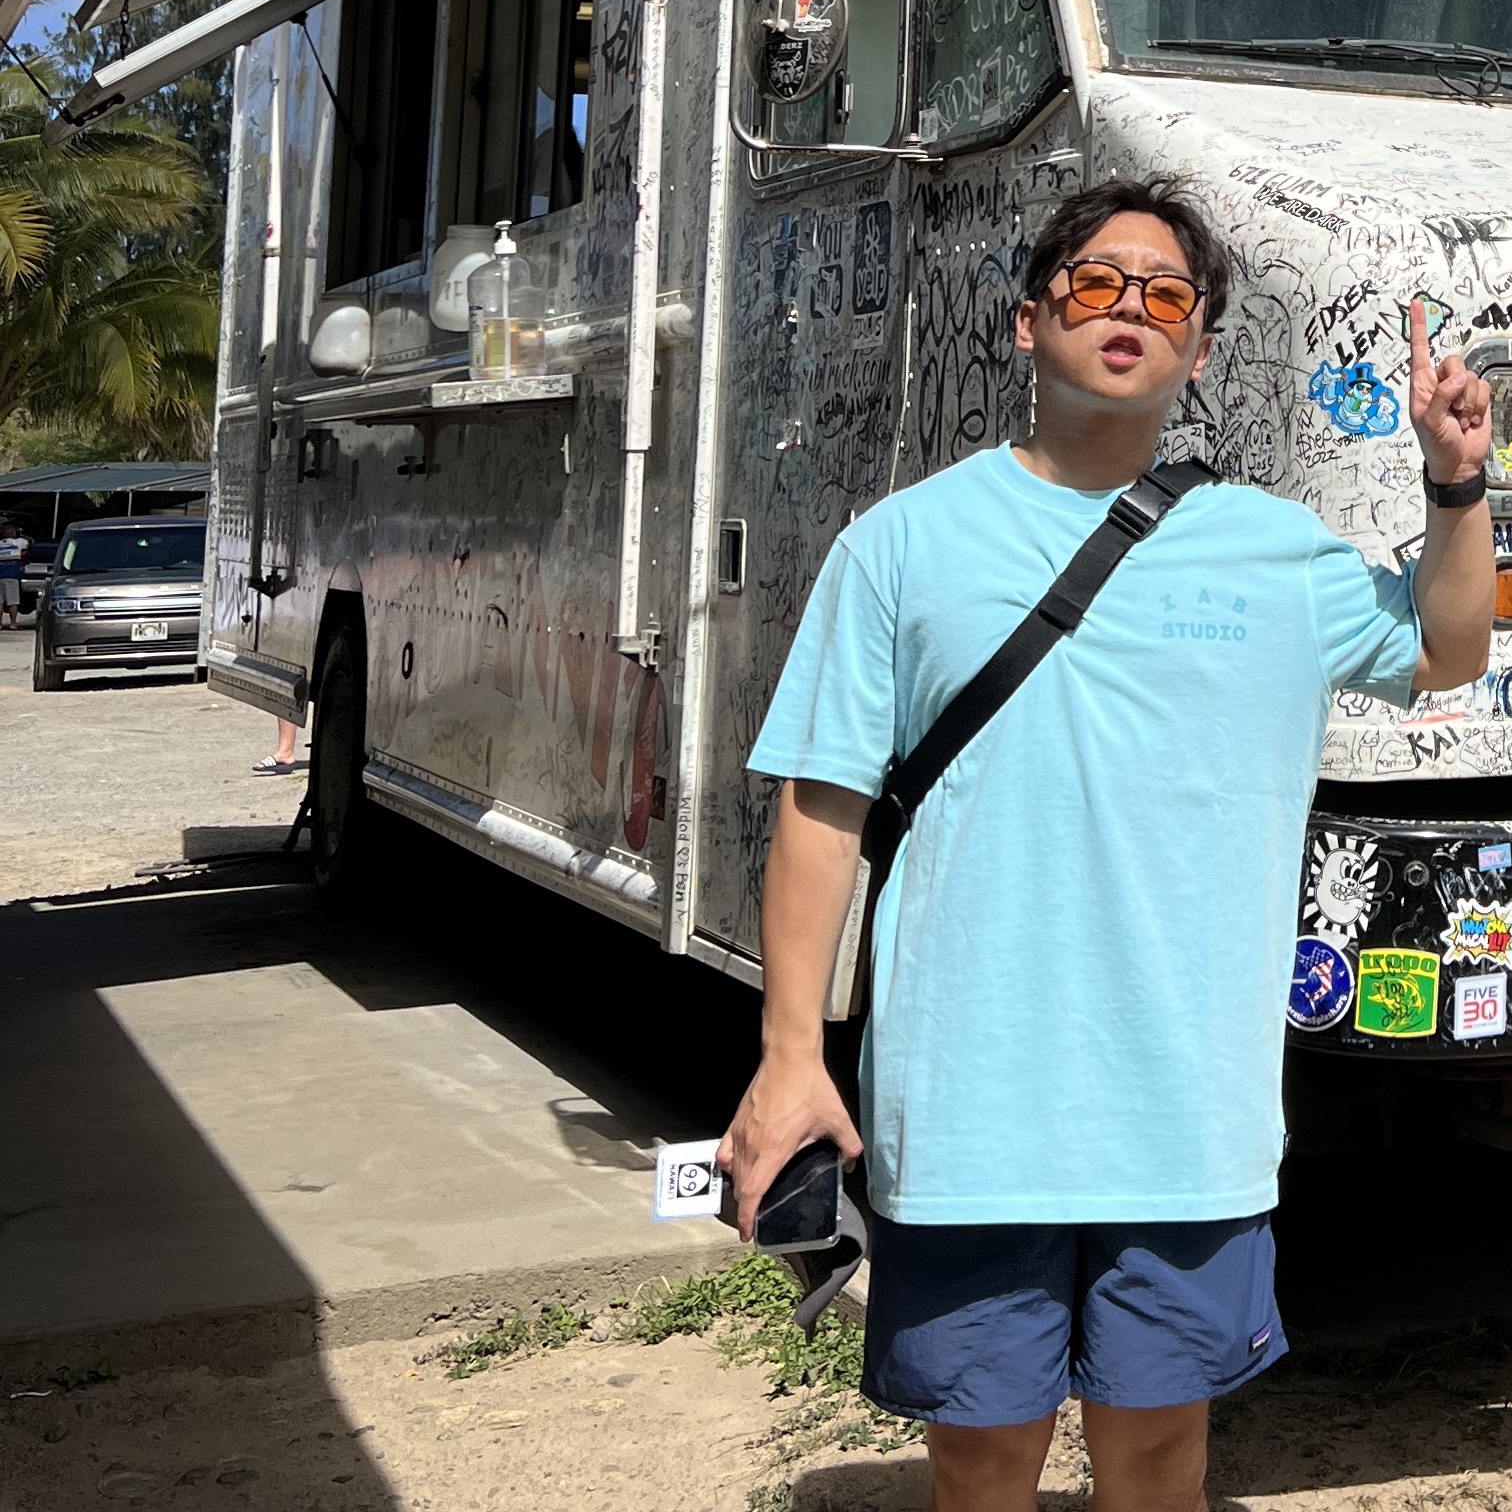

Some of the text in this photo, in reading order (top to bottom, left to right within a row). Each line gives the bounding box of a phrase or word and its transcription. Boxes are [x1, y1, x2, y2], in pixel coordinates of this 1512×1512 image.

[1264, 173, 1334, 198] GUAM
[1252, 186, 1350, 233] WE ARE DARK
[1161, 622, 1247, 642] STUDIO
[1406, 724, 1462, 770] KAI
[1361, 953, 1438, 973] tropo
[1464, 985, 1498, 1001] FIVE
[1463, 1000, 1498, 1023] 30
[682, 1167, 698, 1192] 99
